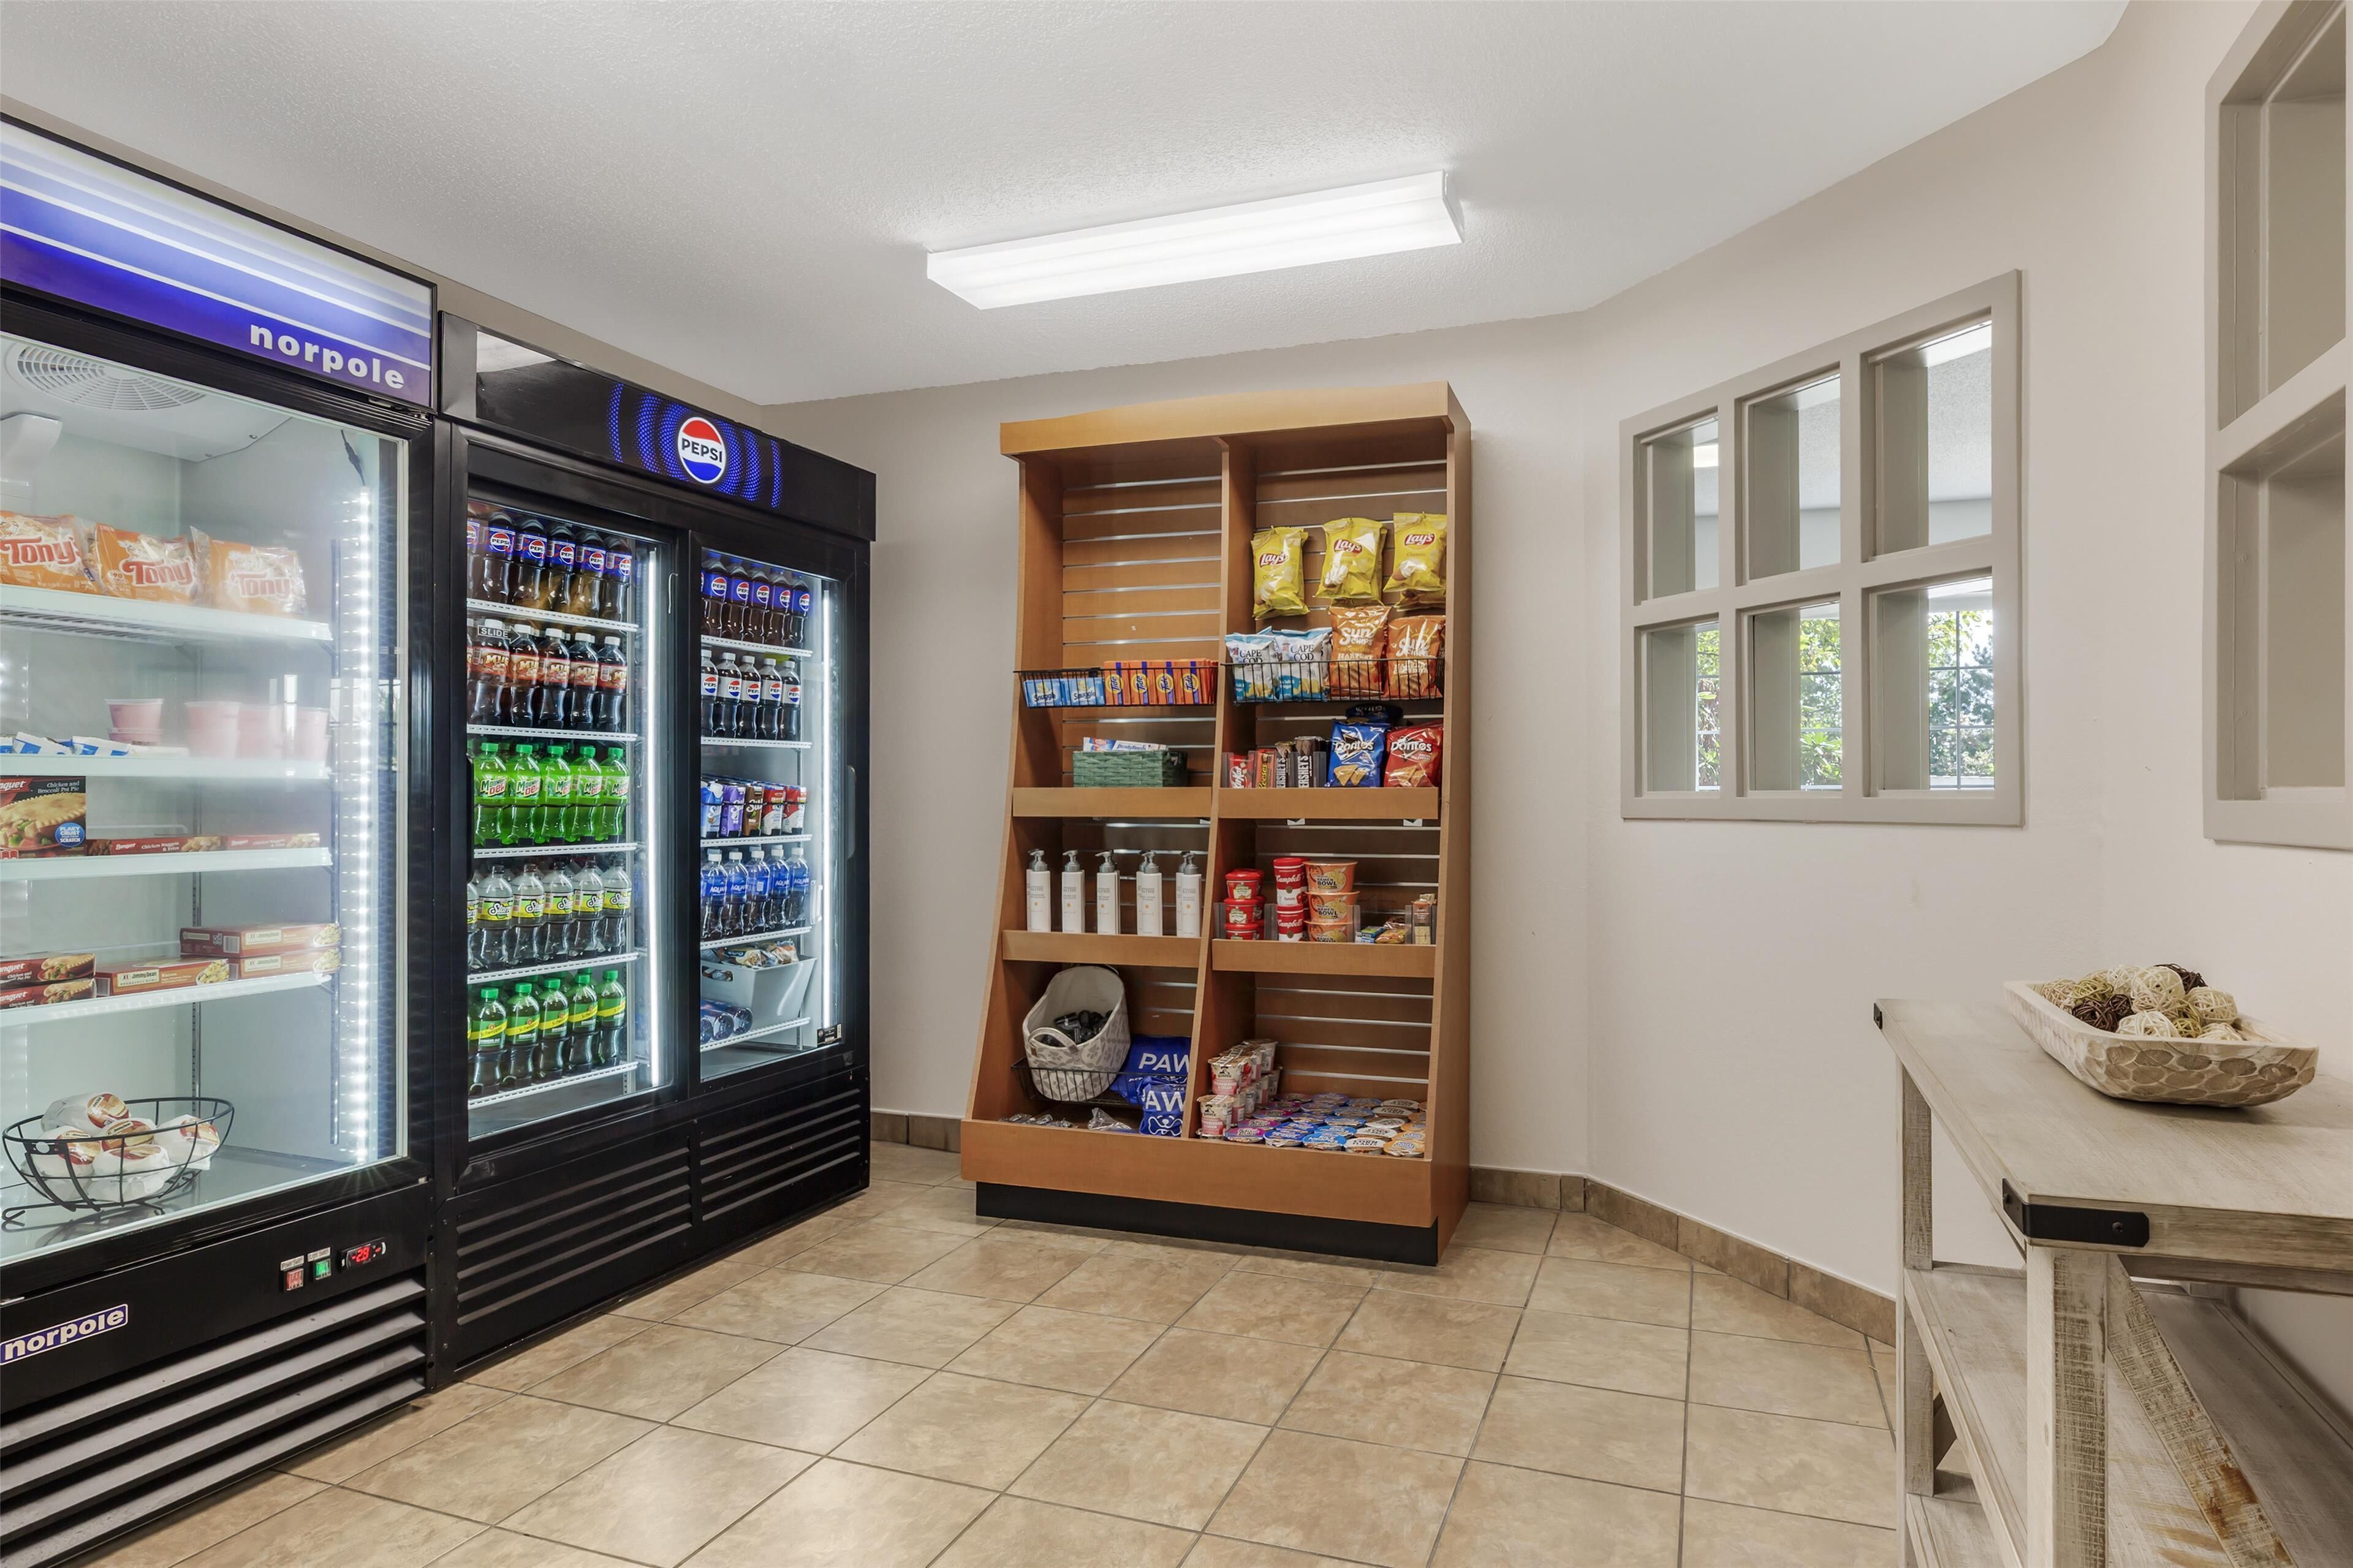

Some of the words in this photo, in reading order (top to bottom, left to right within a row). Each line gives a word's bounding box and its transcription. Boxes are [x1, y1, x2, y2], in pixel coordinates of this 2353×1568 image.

[250, 325, 404, 389] norpole
[681, 437, 722, 463] PEPSI
[1405, 534, 1434, 545] Lay's
[480, 627, 509, 638] SLIDE
[1239, 650, 1262, 658] CAPE
[1291, 645, 1314, 653] CAPE
[486, 654, 509, 665] MUG
[1243, 657, 1263, 666] COD
[1294, 653, 1314, 662] COD
[1111, 676, 1120, 691] Tide
[1137, 675, 1146, 691] Tide
[1161, 675, 1171, 691] Tide
[1185, 675, 1197, 691] Tide
[1034, 693, 1056, 702] Snuggle
[1074, 691, 1096, 700] Snuggle
[1335, 741, 1374, 752] Doritos
[1391, 741, 1431, 752] Doritos
[1298, 756, 1309, 788] ERSHEY'S
[4, 1309, 124, 1361] norpole
